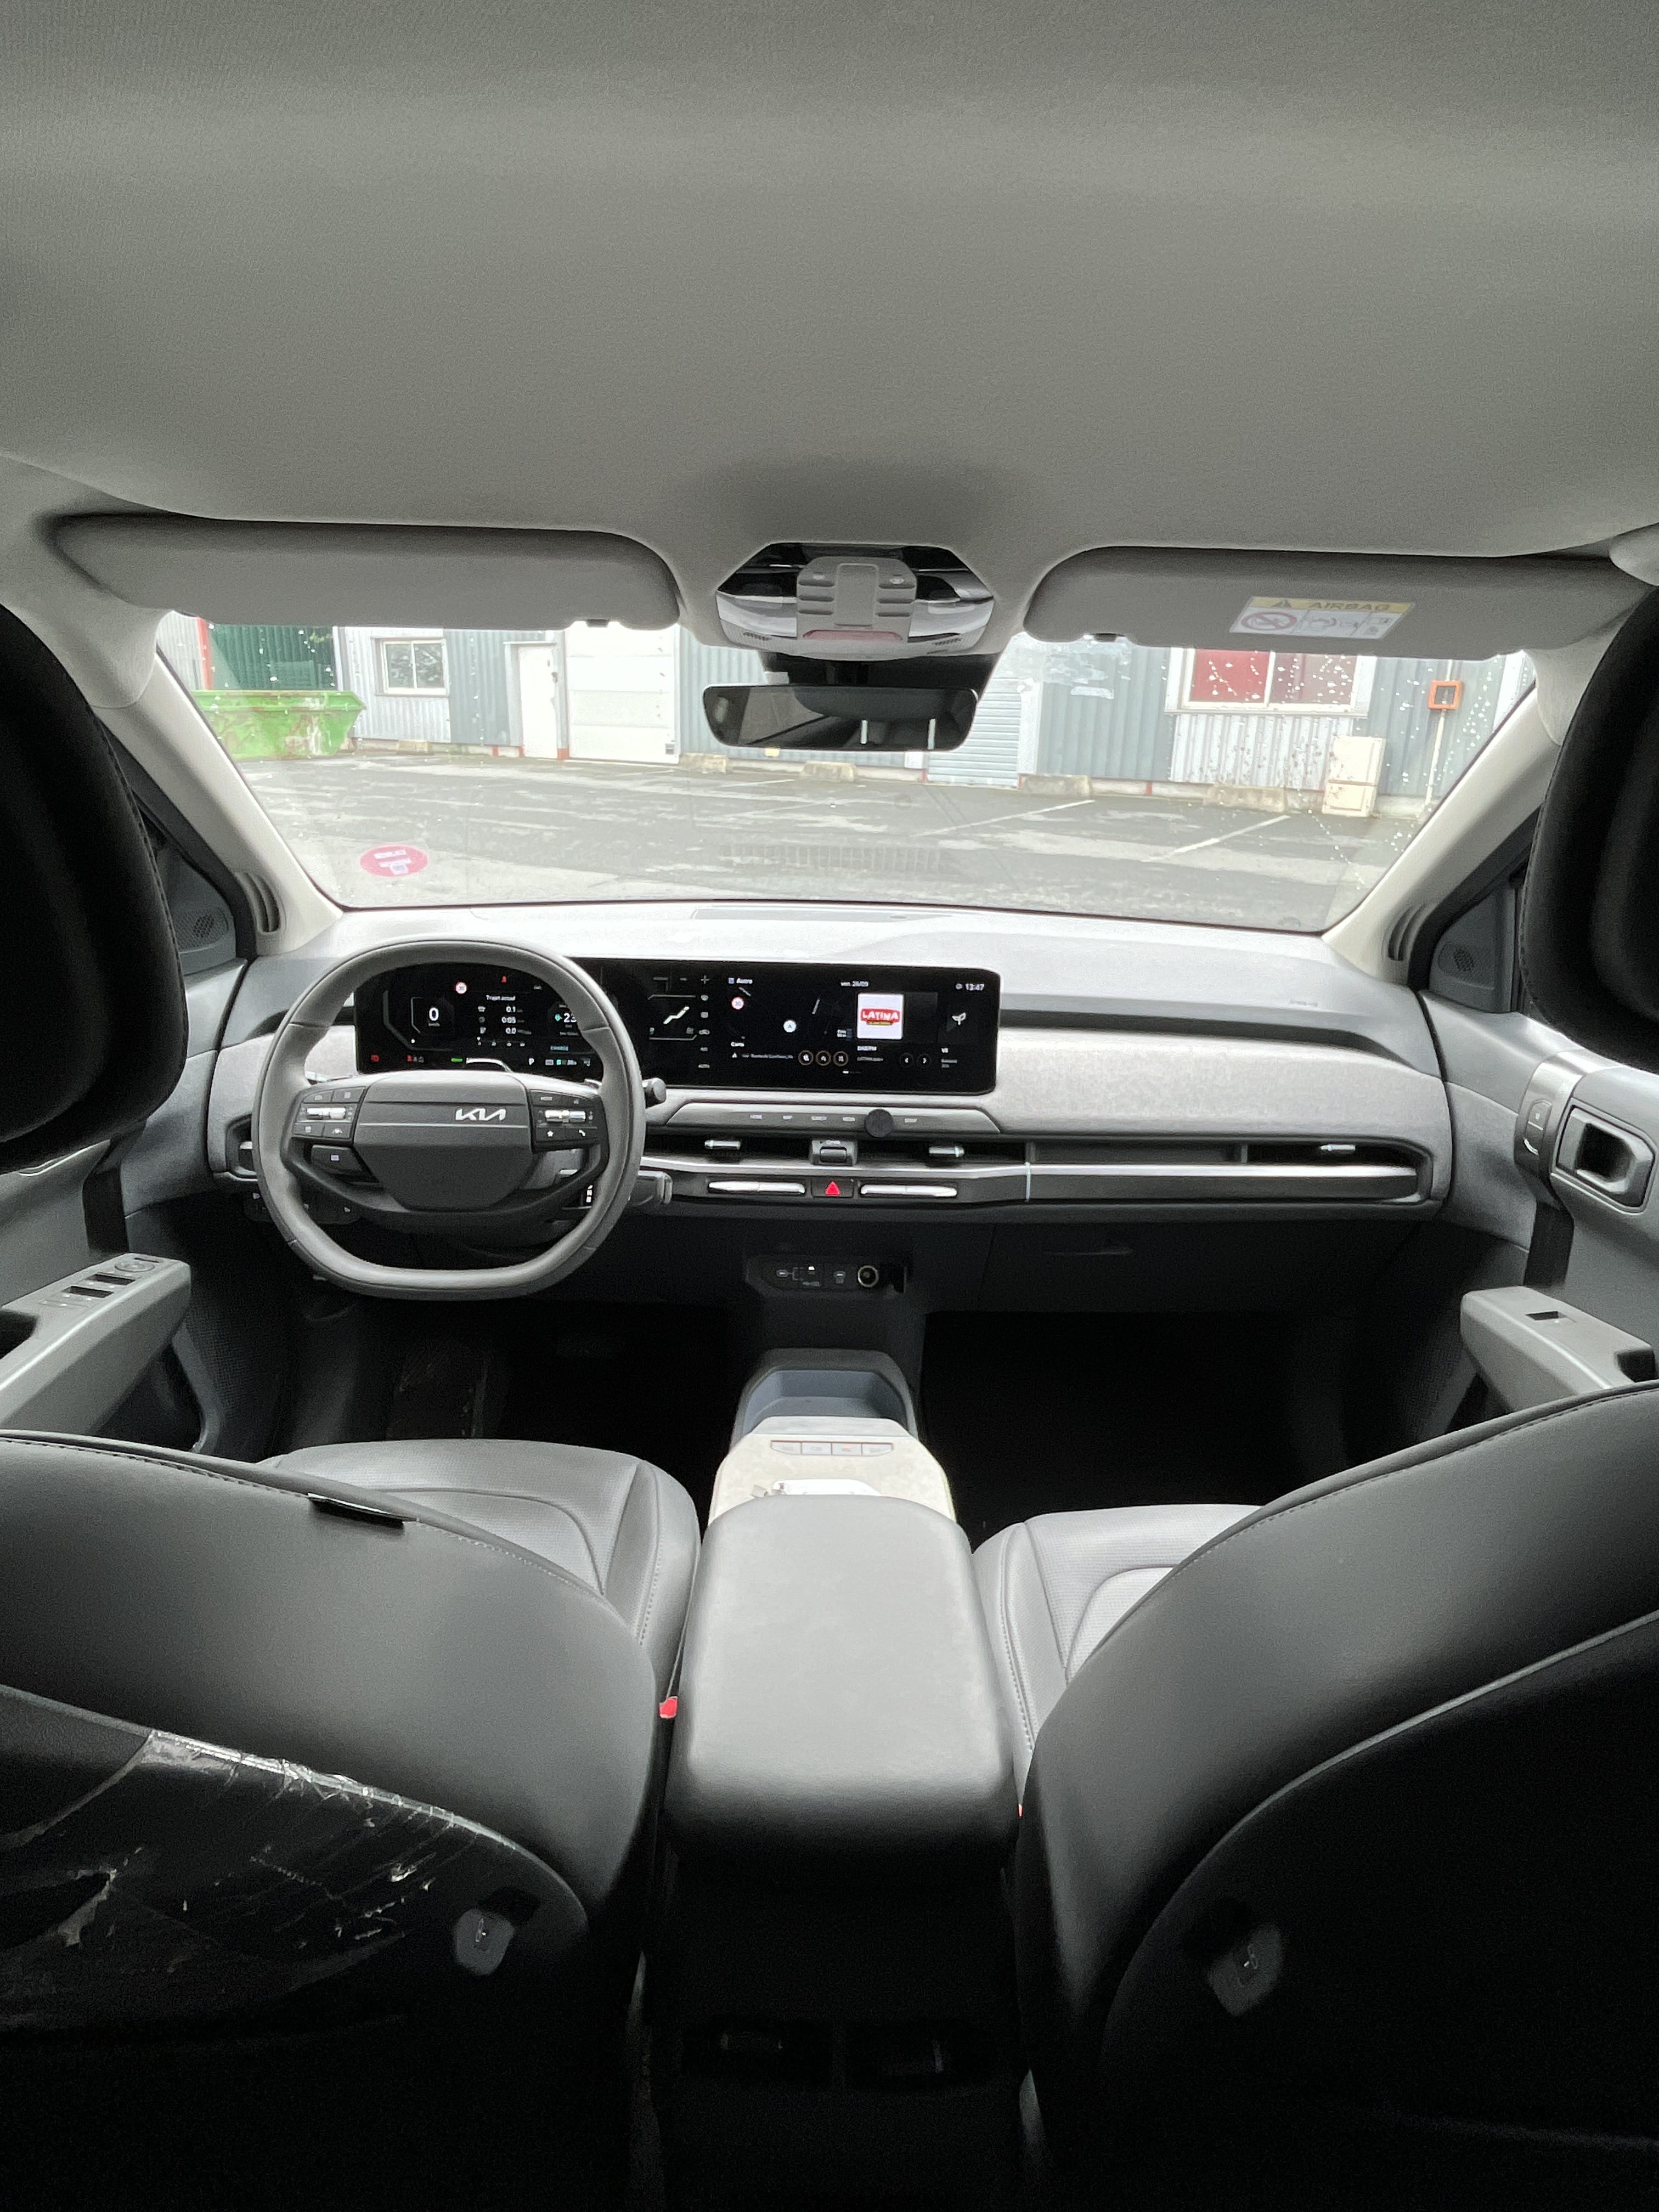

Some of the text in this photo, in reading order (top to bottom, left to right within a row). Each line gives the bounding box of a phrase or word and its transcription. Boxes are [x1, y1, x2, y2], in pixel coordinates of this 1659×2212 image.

[429, 1007, 439, 1021] 0
[862, 1011, 899, 1020] LATINA
[455, 1108, 506, 1121] KIA
